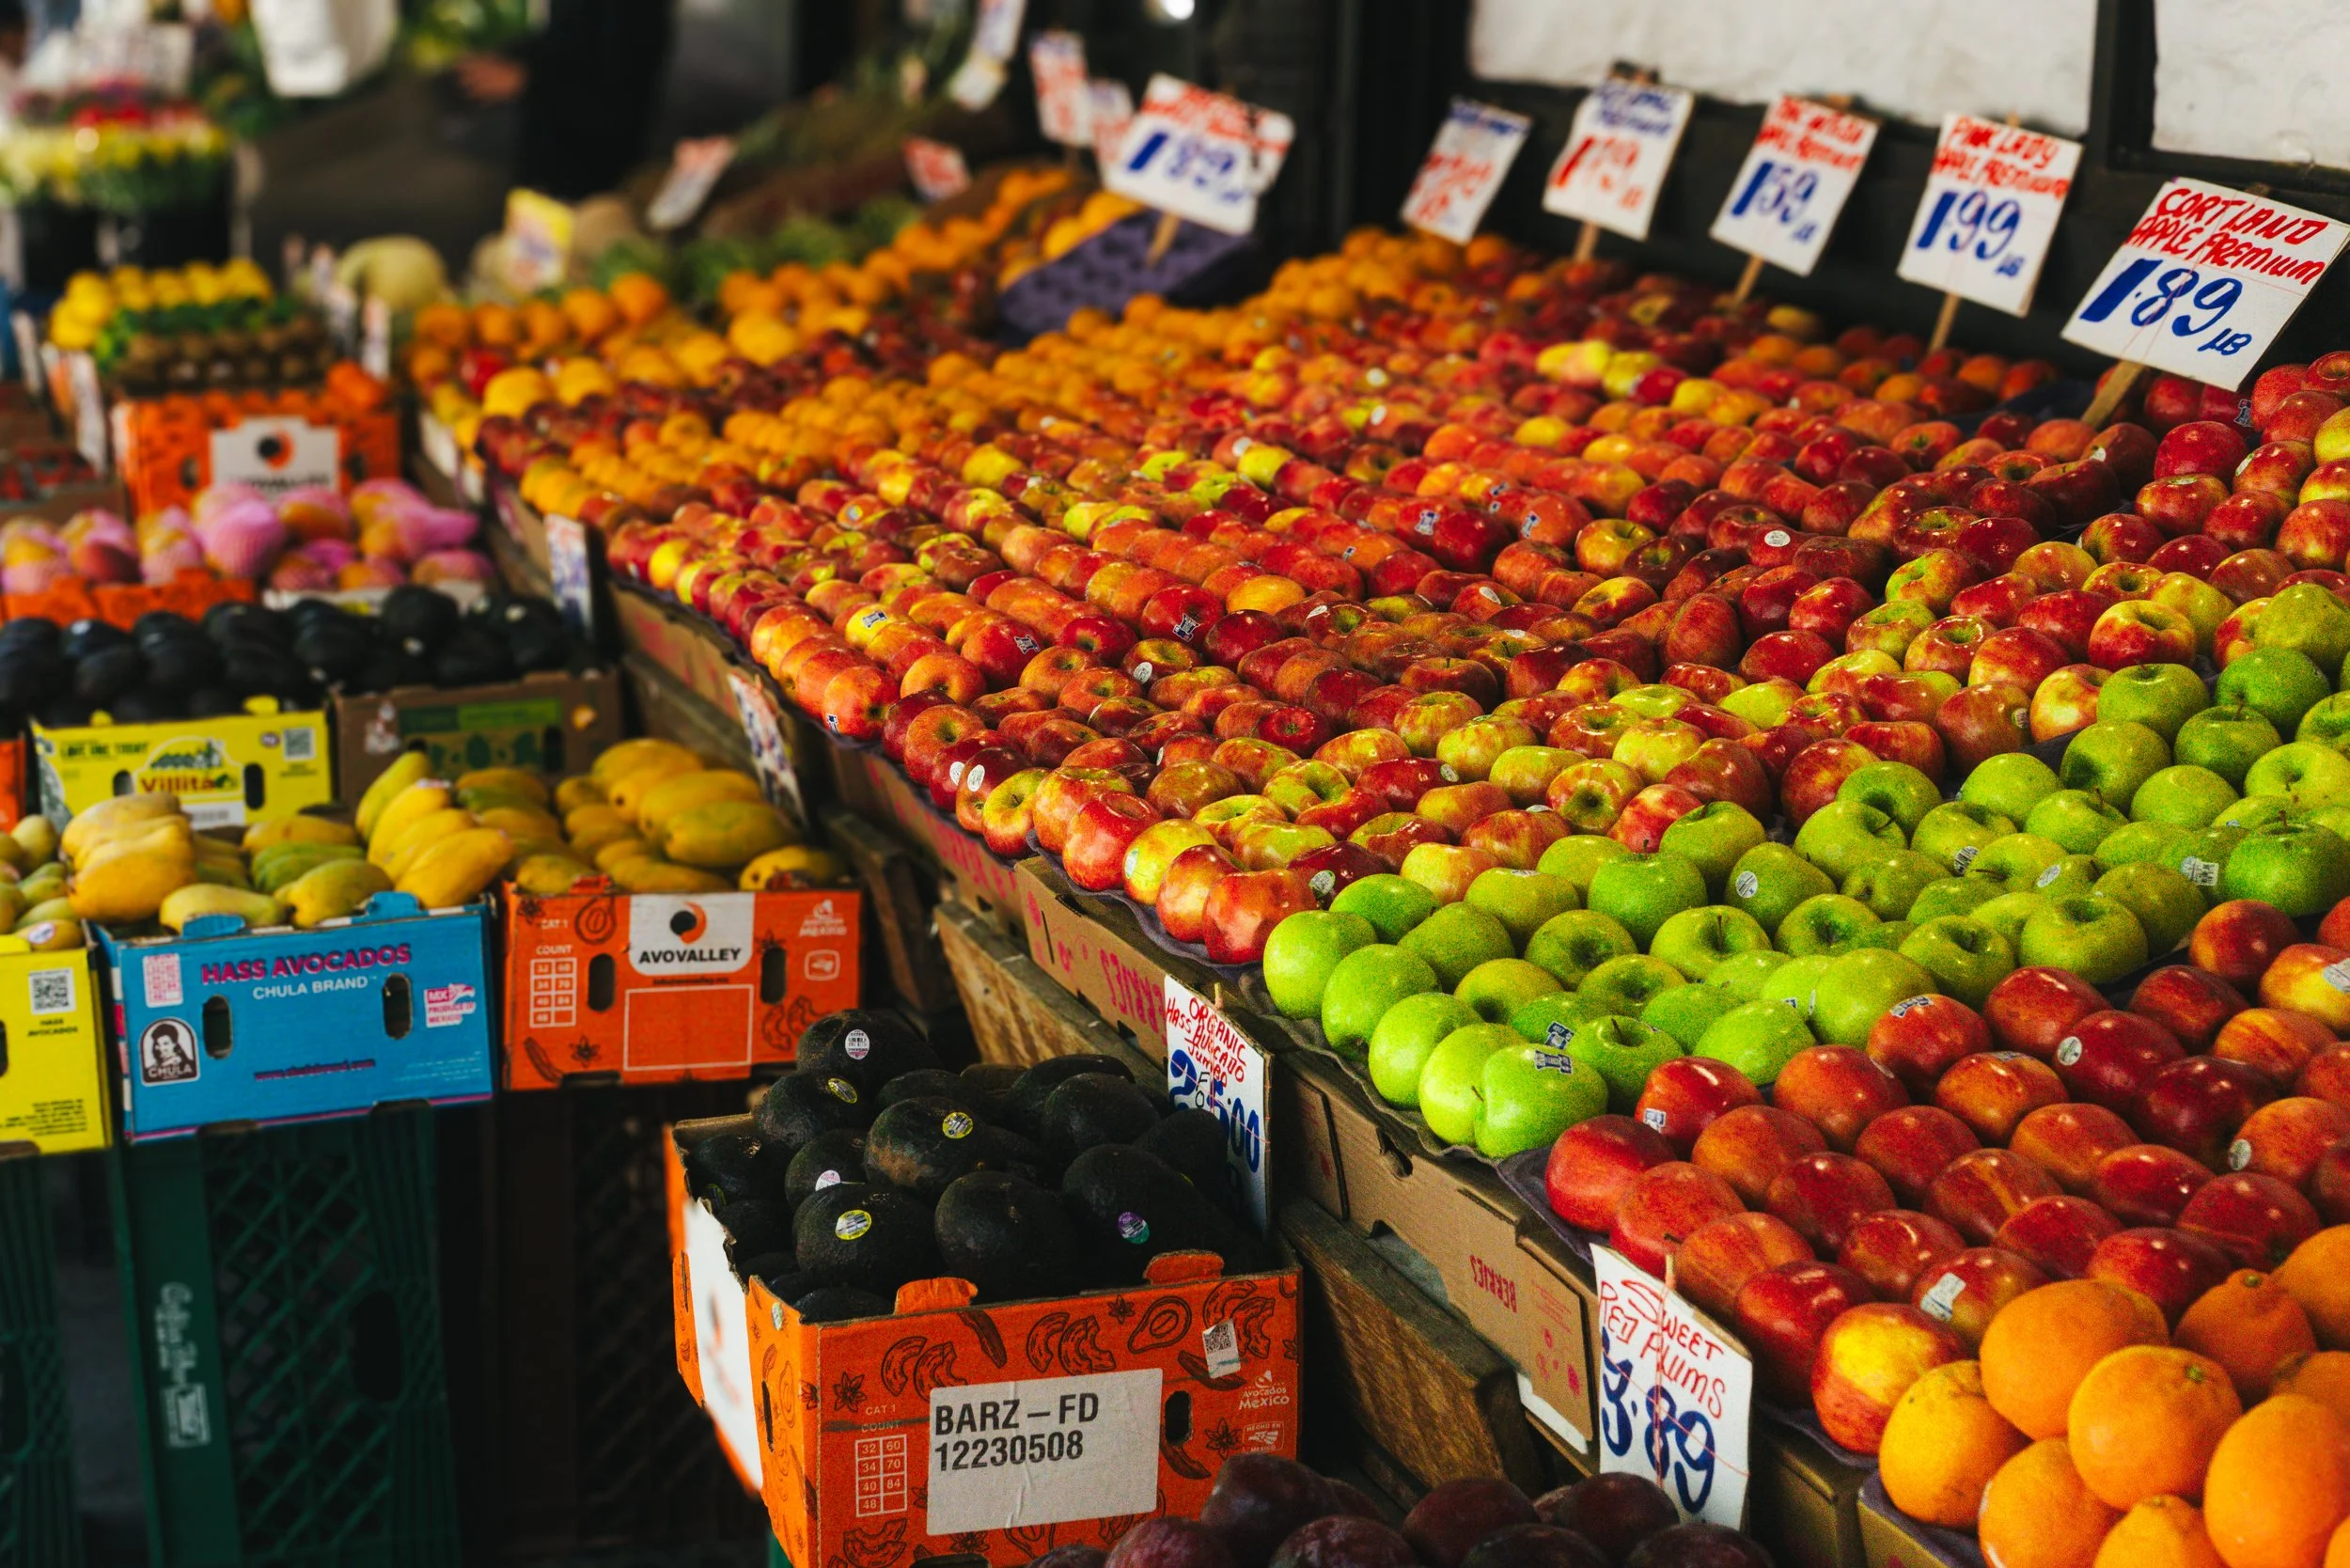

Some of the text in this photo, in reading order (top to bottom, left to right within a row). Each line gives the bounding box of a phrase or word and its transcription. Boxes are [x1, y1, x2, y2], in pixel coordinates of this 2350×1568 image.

[2156, 188, 2329, 245] CORTLAND
[2122, 215, 2326, 286] APPLE PREMIUM
[2197, 327, 2253, 356] LB
[200, 957, 267, 985] HASS
[271, 943, 412, 979] AVOCADOS
[639, 947, 742, 964] AVOVALLEY
[252, 975, 368, 1000] CHULA BRAND
[1166, 996, 1192, 1034] HASS
[1188, 996, 1247, 1067] ORGANIC
[147, 1064, 194, 1078] CHULA
[1469, 1253, 1518, 1314] BERRIES
[1600, 1280, 1639, 1344] RED
[1621, 1278, 1724, 1362] SWEET
[1242, 1386, 1287, 1398] Avocados
[865, 1404, 888, 1416] CAT
[934, 1399, 1021, 1436] BARZ
[1058, 1391, 1100, 1425] FD
[860, 1419, 901, 1433] COUNT
[1246, 1424, 1270, 1433] HECHO
[861, 1443, 877, 1455] 32
[885, 1440, 901, 1452] 60
[934, 1429, 1084, 1472] 12230508
[862, 1461, 877, 1474] 34
[885, 1458, 901, 1470] 70
[862, 1481, 877, 1492] 40
[885, 1477, 901, 1490] 84
[862, 1498, 877, 1510] 48
